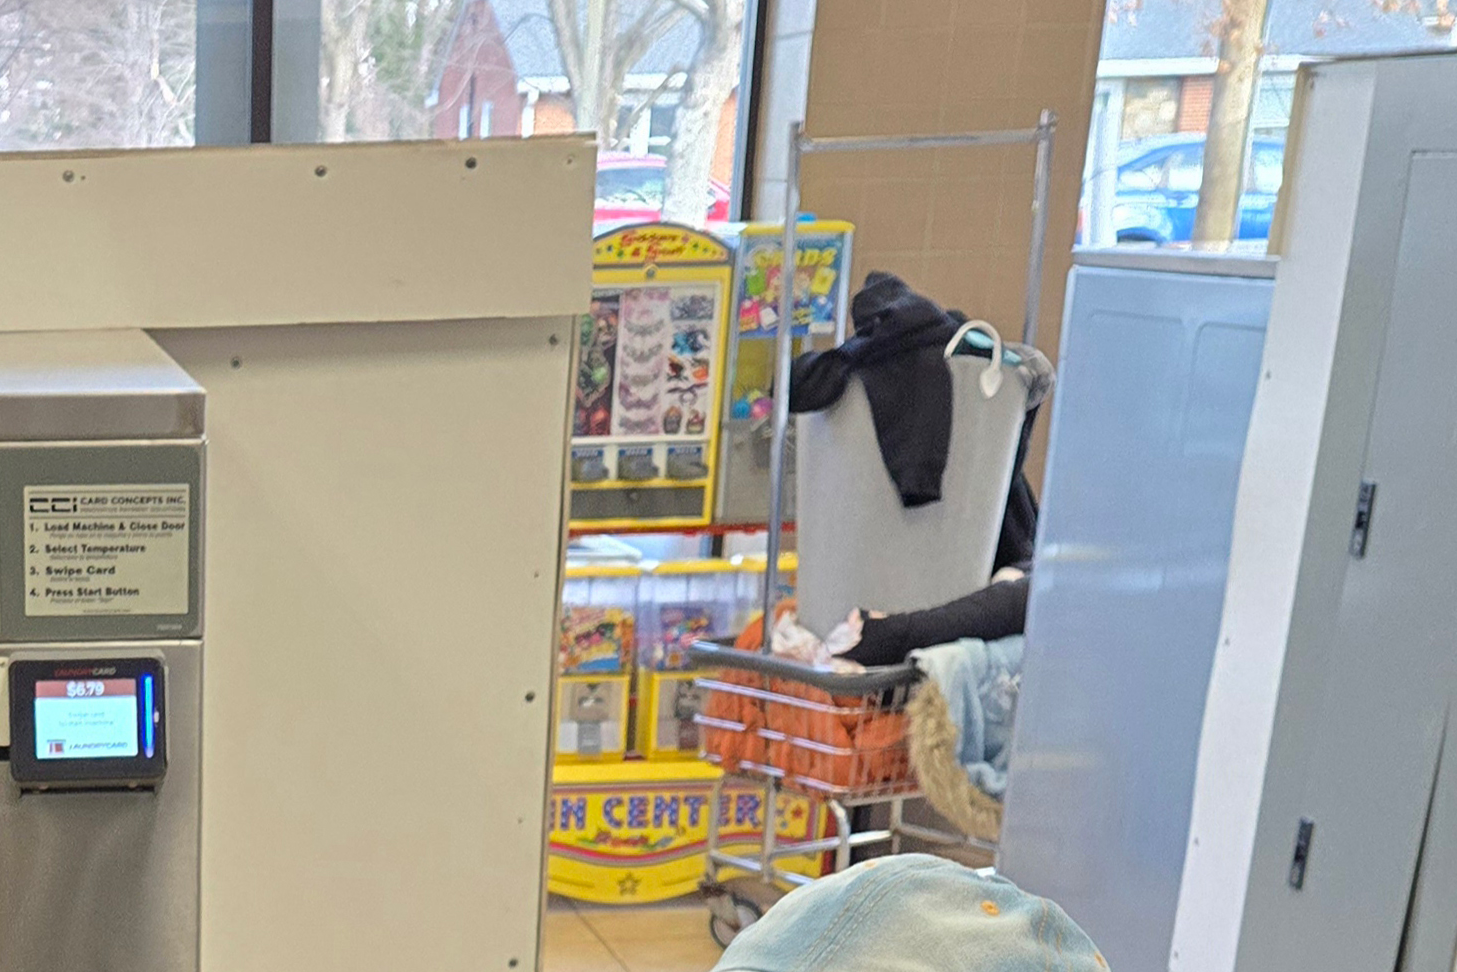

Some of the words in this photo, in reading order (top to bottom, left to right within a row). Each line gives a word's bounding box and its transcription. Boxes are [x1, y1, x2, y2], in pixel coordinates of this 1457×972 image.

[80, 497, 108, 505] CARD
[111, 496, 163, 505] CONCEPTS
[166, 496, 186, 505] INC.
[30, 523, 39, 532] 1.
[44, 522, 69, 532] Load
[73, 522, 115, 531] Machine
[119, 522, 125, 531] &
[130, 521, 157, 531] Close
[161, 521, 185, 530] Door
[30, 545, 39, 554] 2.
[45, 544, 78, 554] Select
[81, 543, 146, 555] Temperature
[30, 567, 39, 576] 3.
[45, 566, 82, 577] Swipe
[86, 565, 116, 575] Card
[30, 588, 39, 597] 4.
[45, 588, 73, 597] Press
[77, 587, 102, 596] Start
[105, 587, 140, 596] Button
[66, 680, 105, 698] $6.79
[603, 794, 760, 829] CENTER
